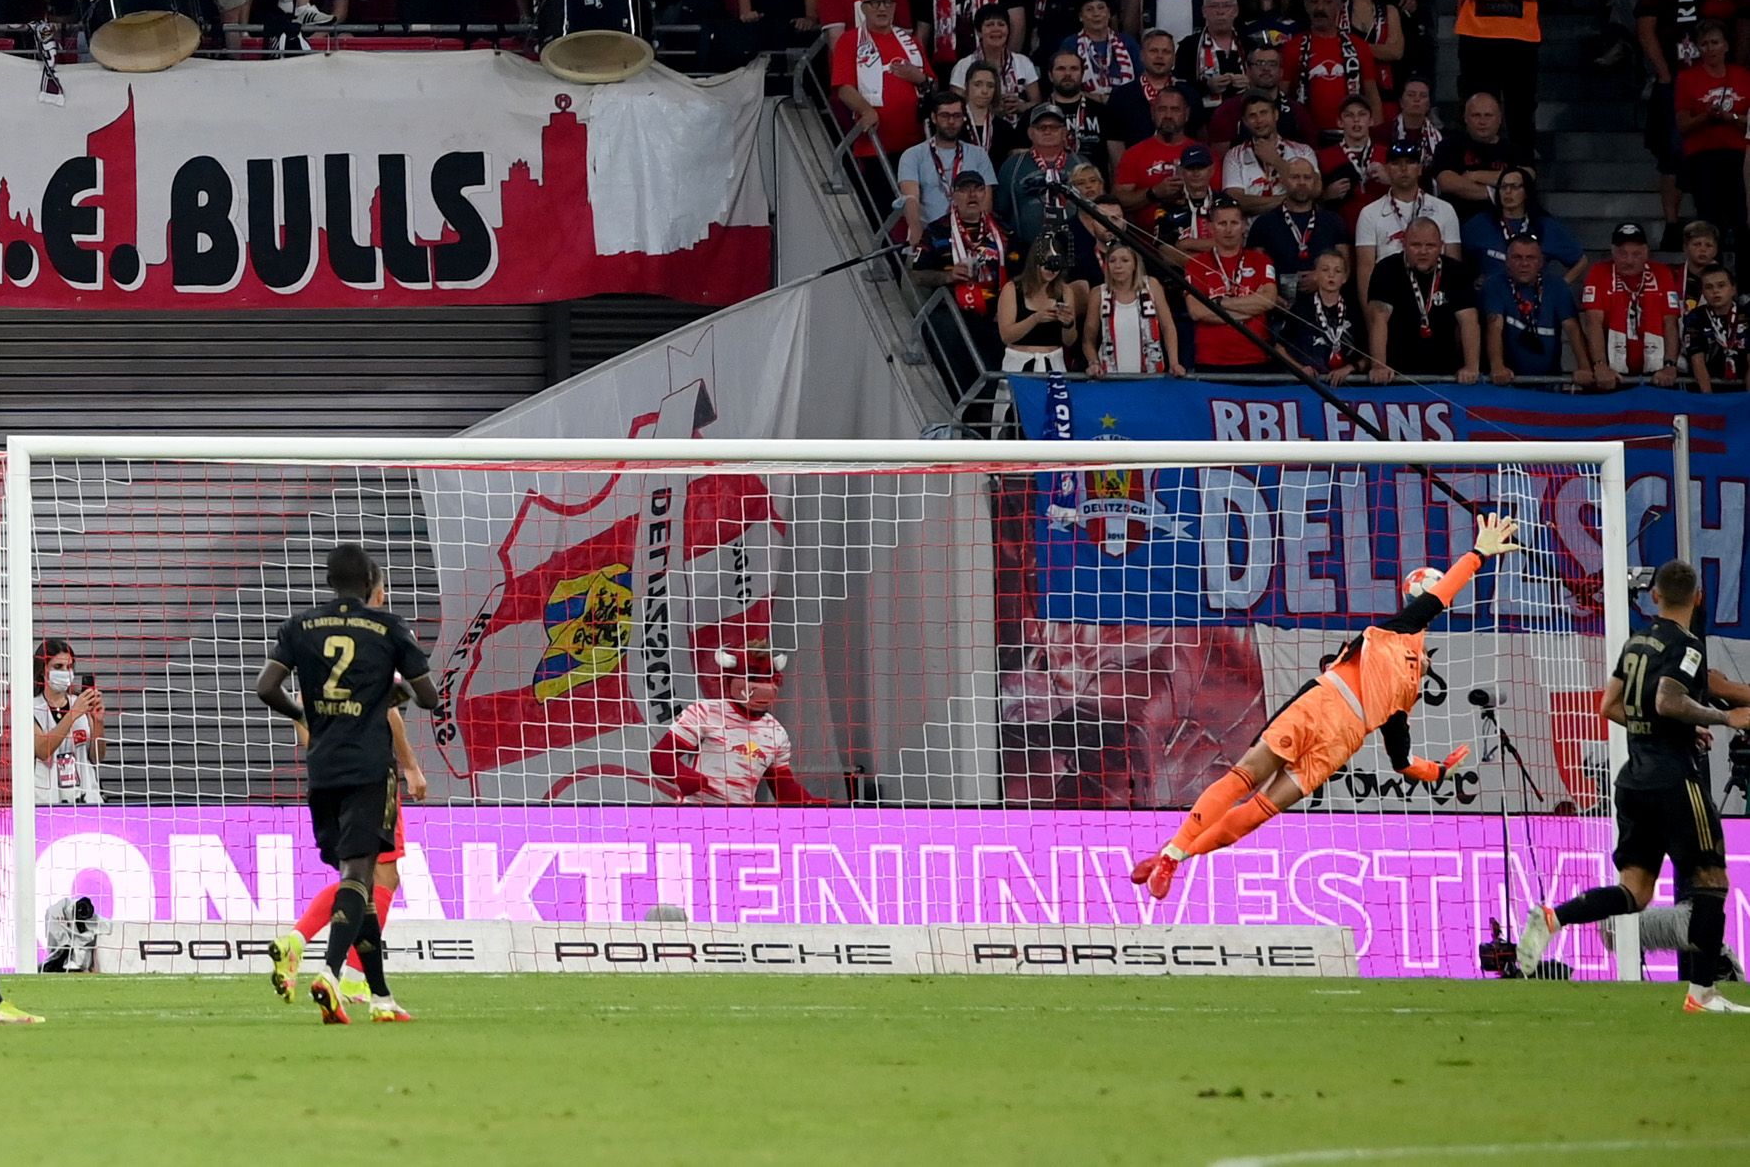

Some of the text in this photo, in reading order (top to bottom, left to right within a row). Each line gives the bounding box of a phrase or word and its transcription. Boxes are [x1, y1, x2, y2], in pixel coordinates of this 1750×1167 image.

[171, 151, 498, 294] BULLS
[323, 635, 356, 701] 2
[1623, 651, 1649, 718] 21
[554, 941, 894, 966] PORSCHE
[973, 942, 1316, 968] PORSCHE
